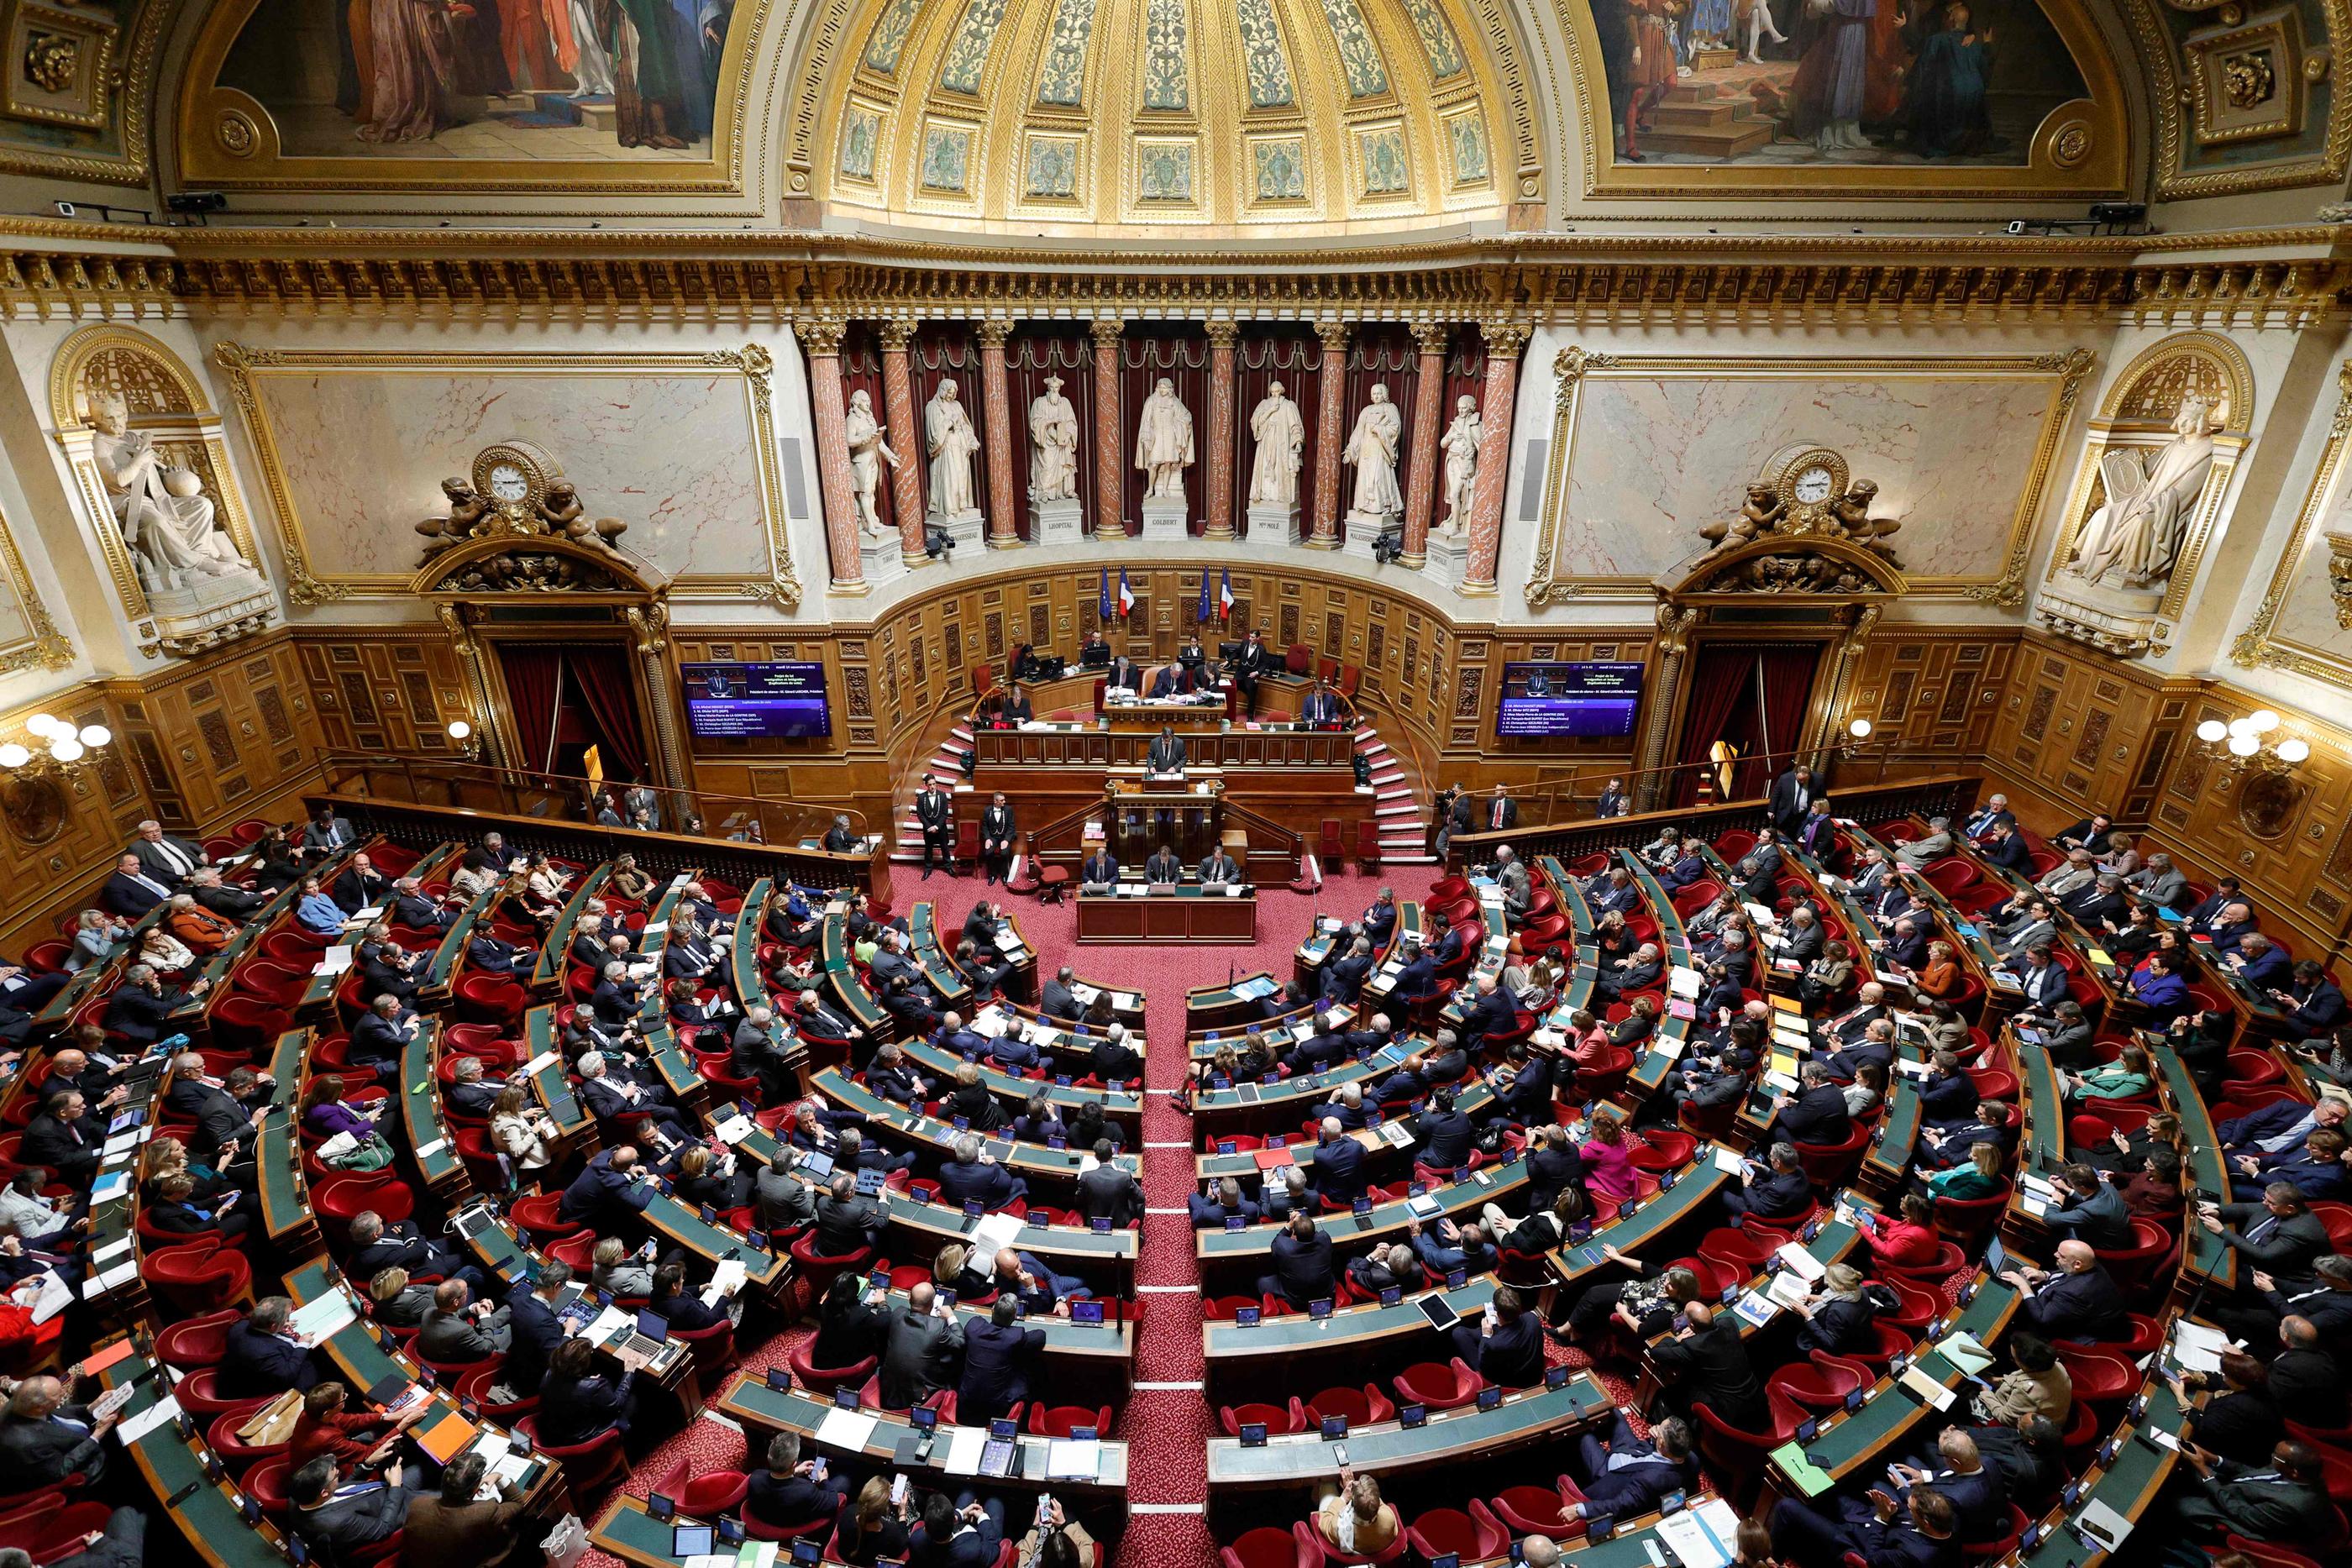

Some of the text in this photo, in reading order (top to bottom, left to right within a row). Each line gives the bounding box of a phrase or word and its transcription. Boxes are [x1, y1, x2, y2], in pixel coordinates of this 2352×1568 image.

[953, 532, 977, 541] AGUESSEAU
[882, 553, 895, 565] TURGOT
[1431, 553, 1447, 565] PORTALIS
